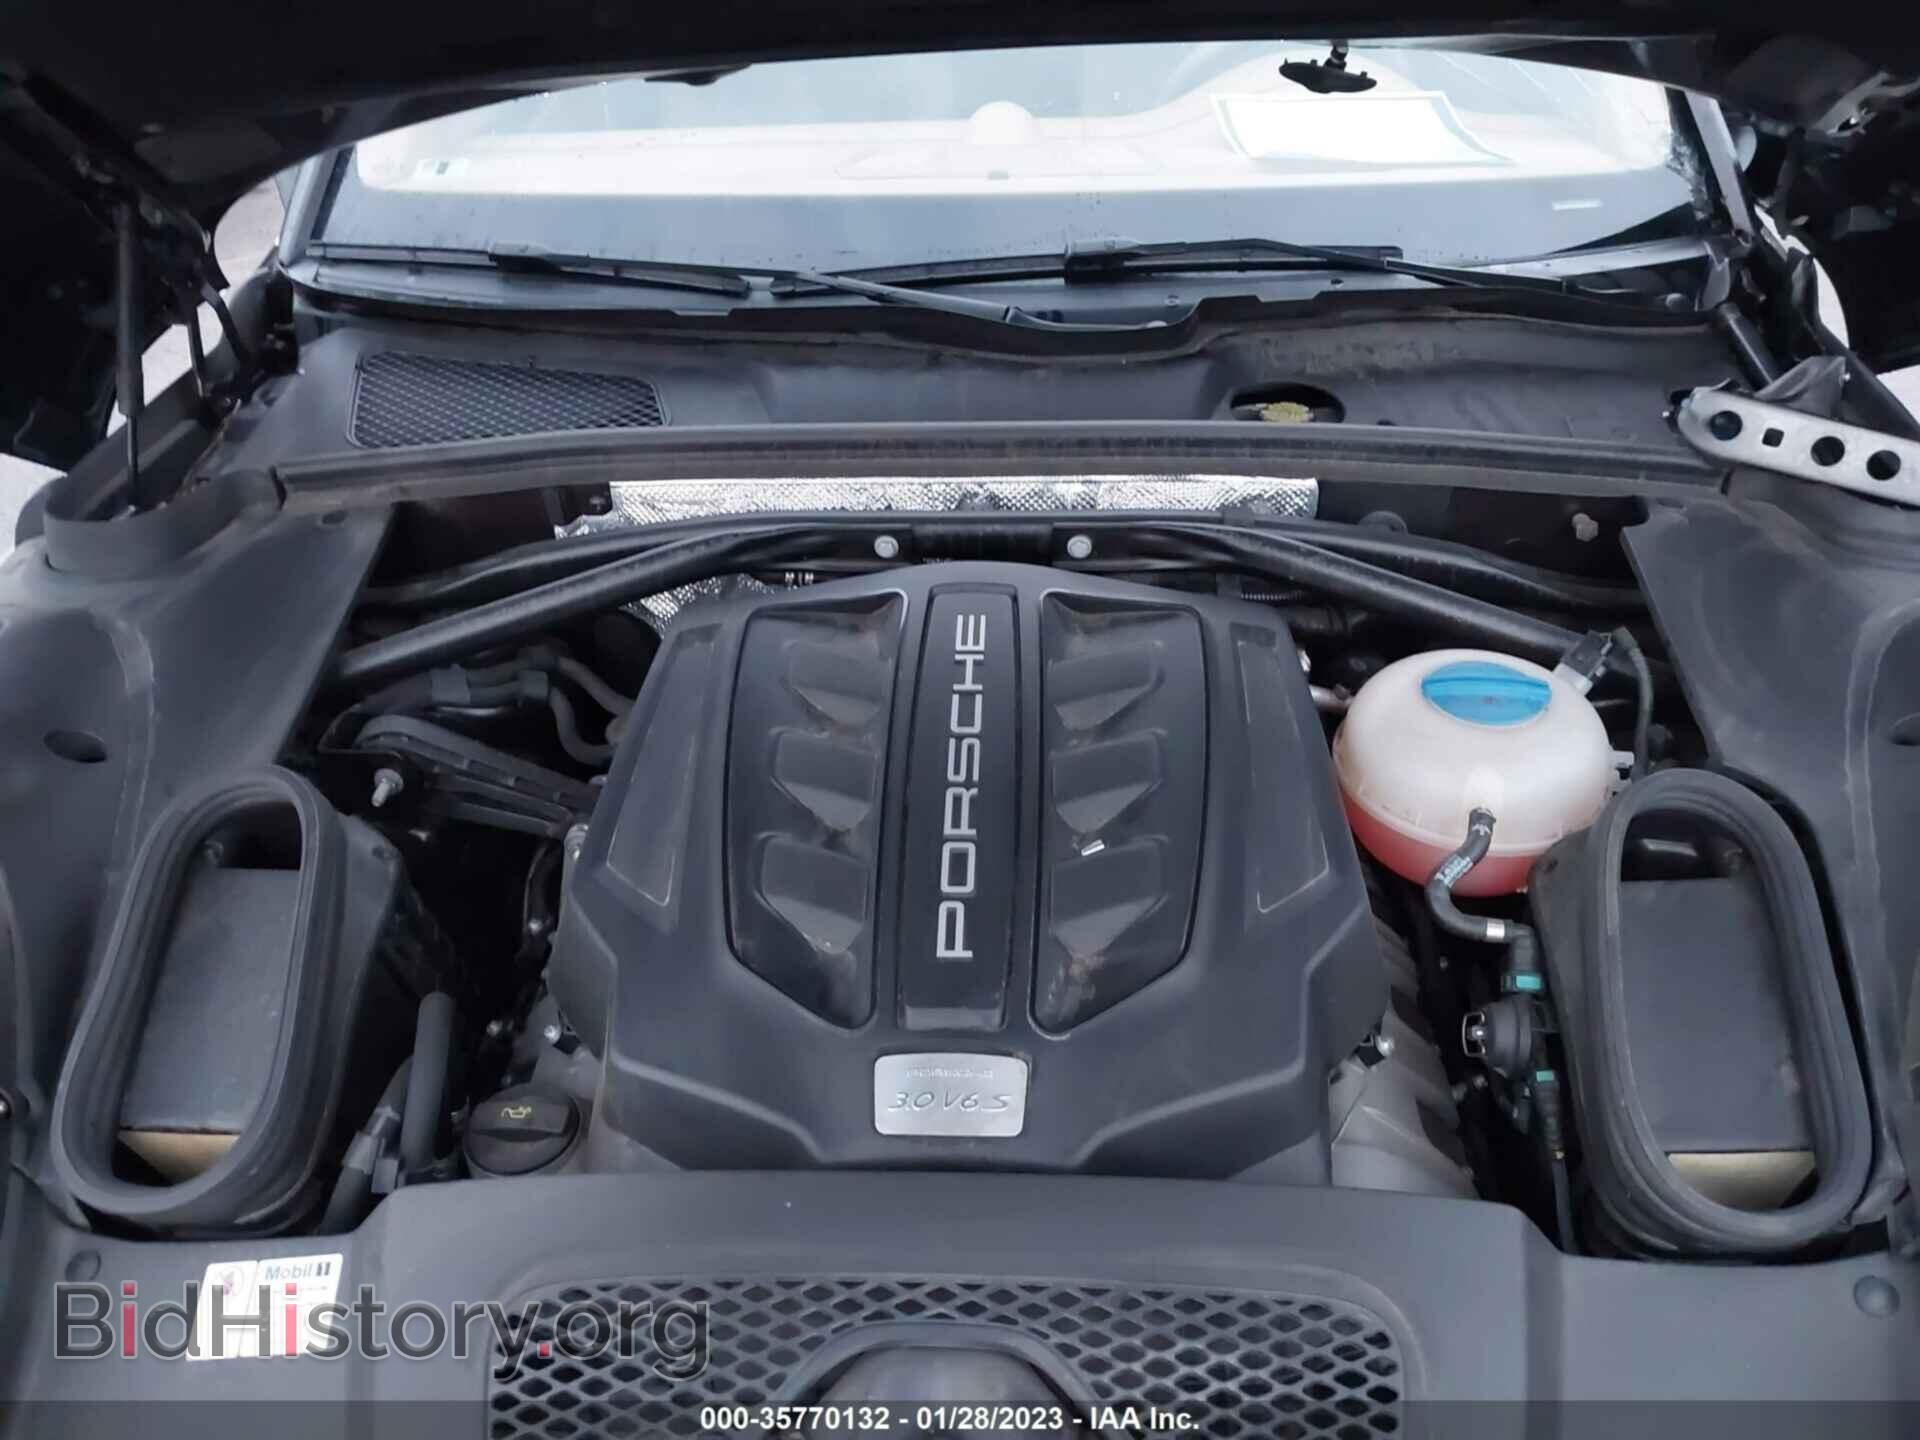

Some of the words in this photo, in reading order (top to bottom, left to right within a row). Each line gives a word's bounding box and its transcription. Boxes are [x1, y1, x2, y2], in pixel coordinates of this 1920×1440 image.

[935, 613, 987, 960] PORSCHE
[943, 1087, 980, 1112] V6
[265, 1263, 313, 1280] Mobil
